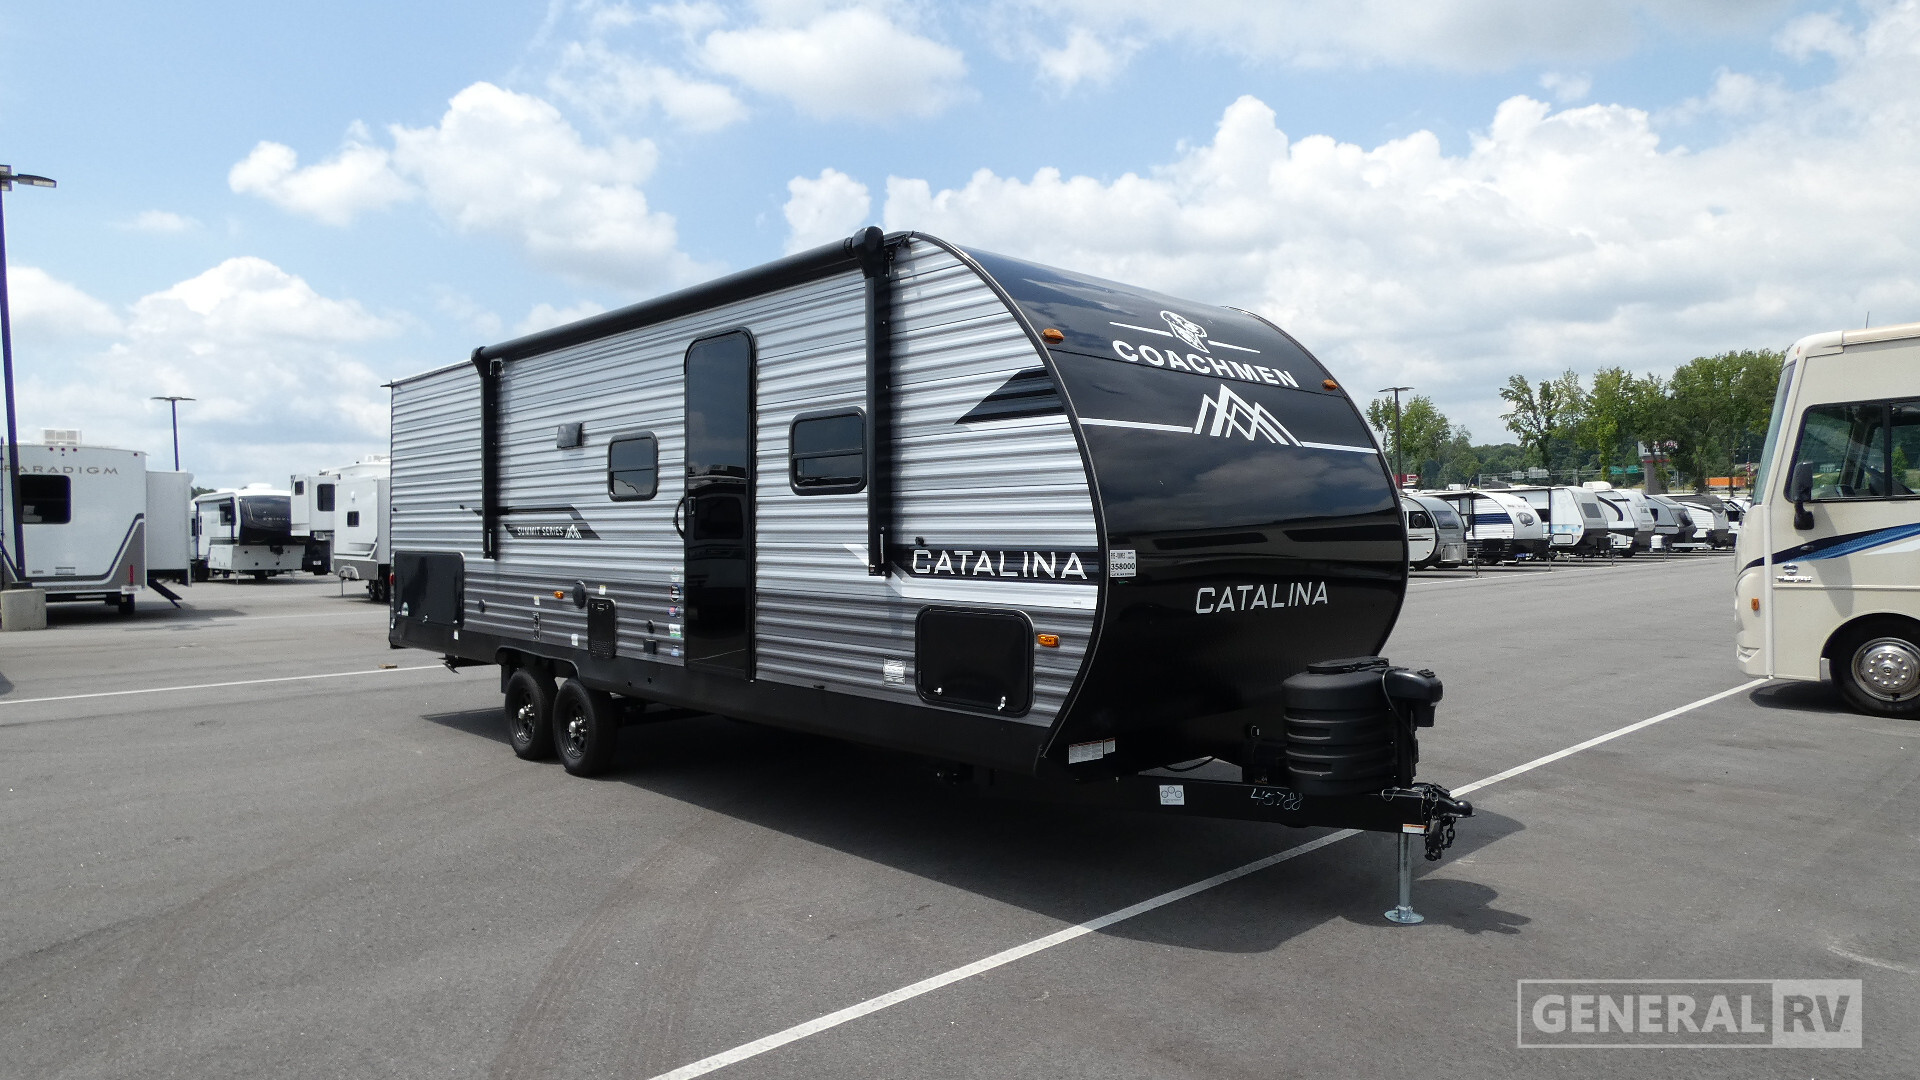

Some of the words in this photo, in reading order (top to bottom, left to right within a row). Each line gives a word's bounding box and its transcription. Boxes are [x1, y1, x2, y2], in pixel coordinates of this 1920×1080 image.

[1112, 340, 1299, 388] COACHMEN
[517, 526, 541, 536] SUMMIT
[541, 526, 564, 536] SERIES
[912, 549, 1088, 580] CATALINA
[1195, 581, 1328, 614] CATALINA
